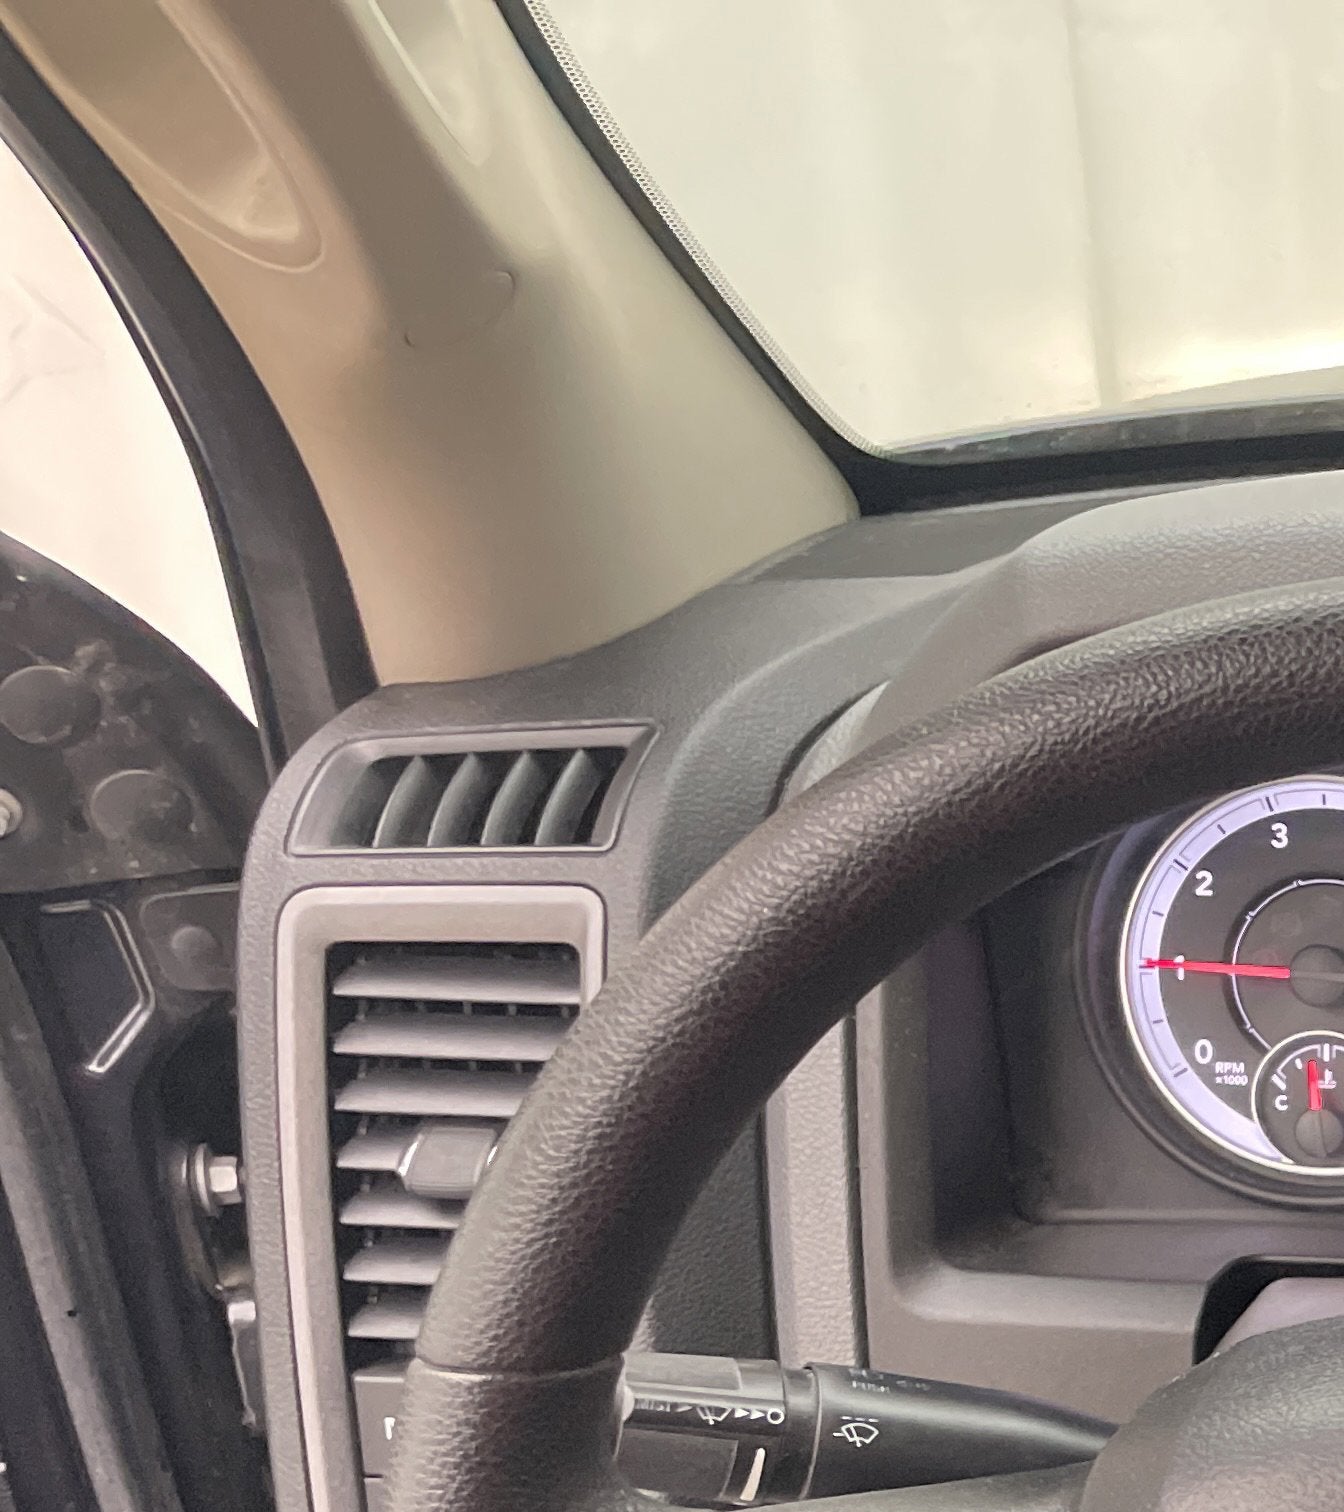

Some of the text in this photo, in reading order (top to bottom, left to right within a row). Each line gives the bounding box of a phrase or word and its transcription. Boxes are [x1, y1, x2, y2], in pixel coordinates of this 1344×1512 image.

[1270, 822, 1289, 849] 3
[1194, 871, 1214, 897] 2
[1194, 1038, 1214, 1064] 0
[1214, 1061, 1246, 1074] RPM
[1274, 1094, 1289, 1111] C
